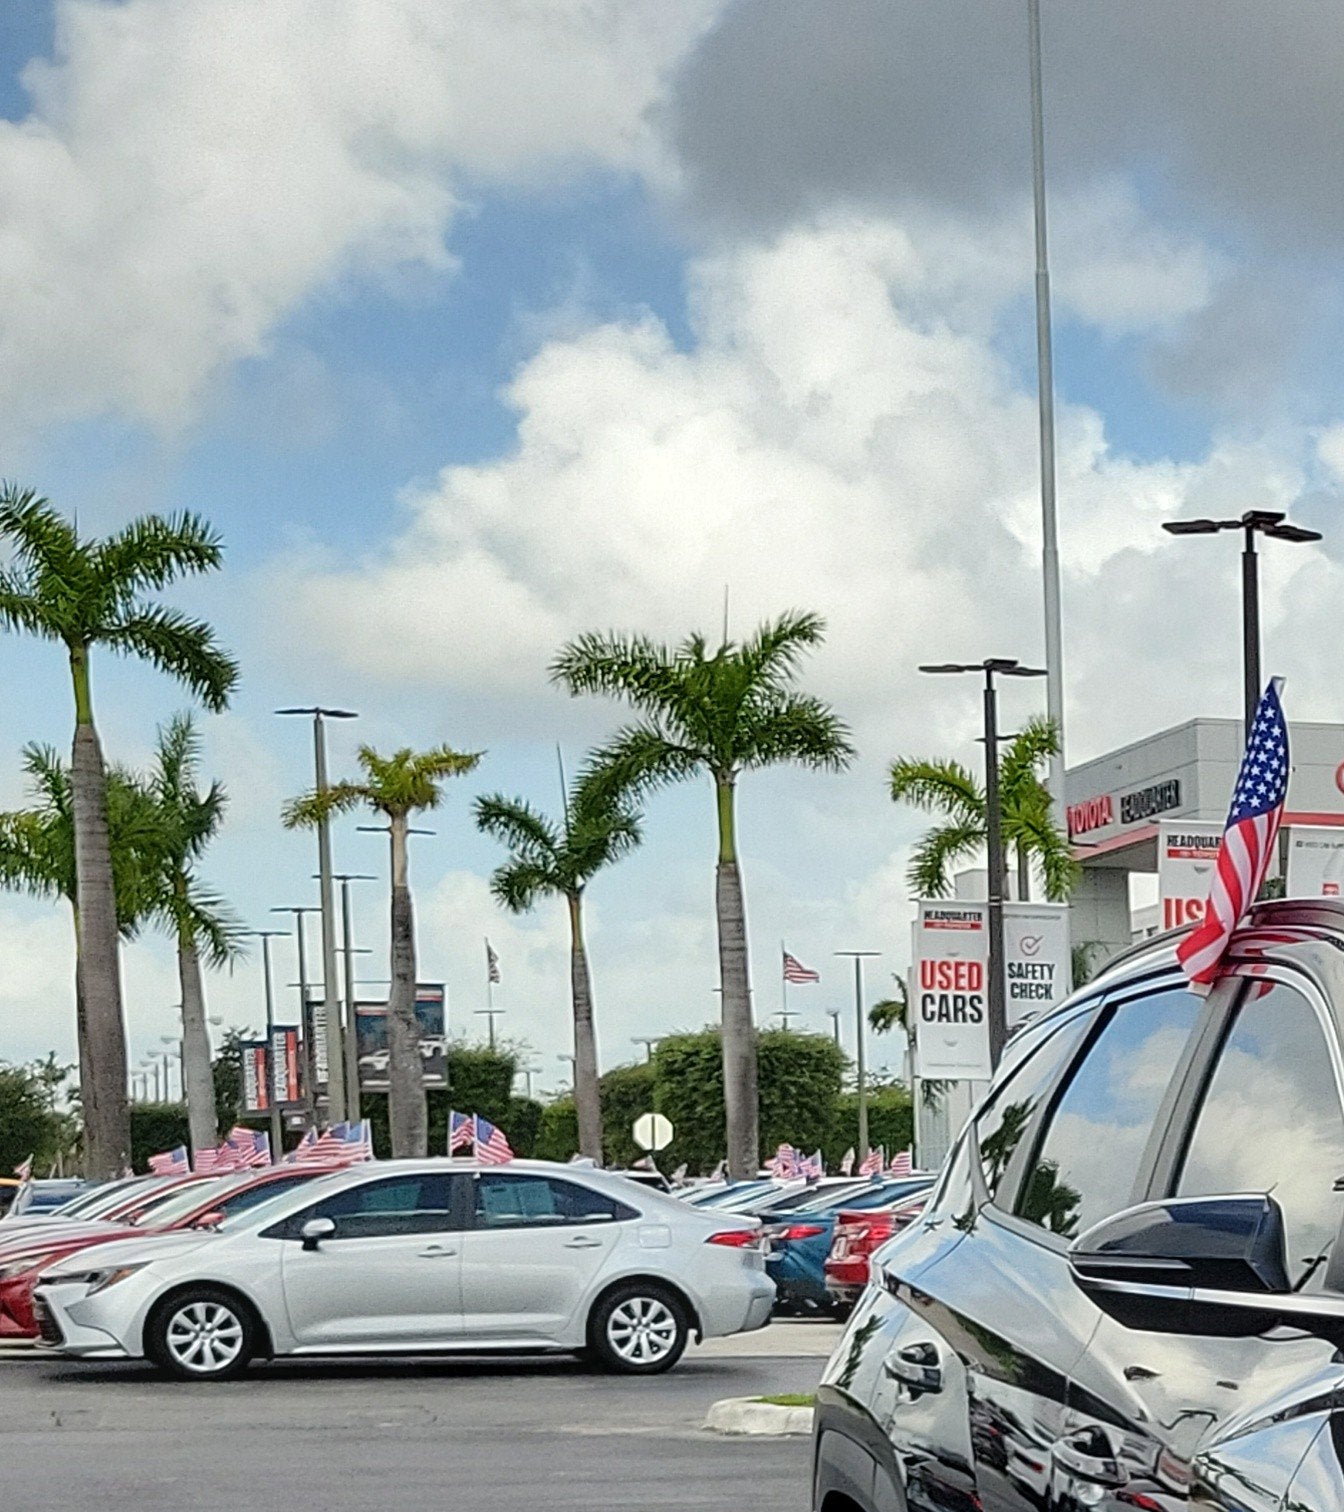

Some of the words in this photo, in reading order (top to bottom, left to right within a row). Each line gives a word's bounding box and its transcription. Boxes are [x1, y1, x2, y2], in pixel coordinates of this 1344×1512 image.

[1167, 835, 1221, 849] HEADQUA
[921, 960, 983, 992] USED
[1008, 962, 1055, 981] SAFETY
[1010, 982, 1053, 1000] CHECK
[921, 993, 983, 1024] CARS
